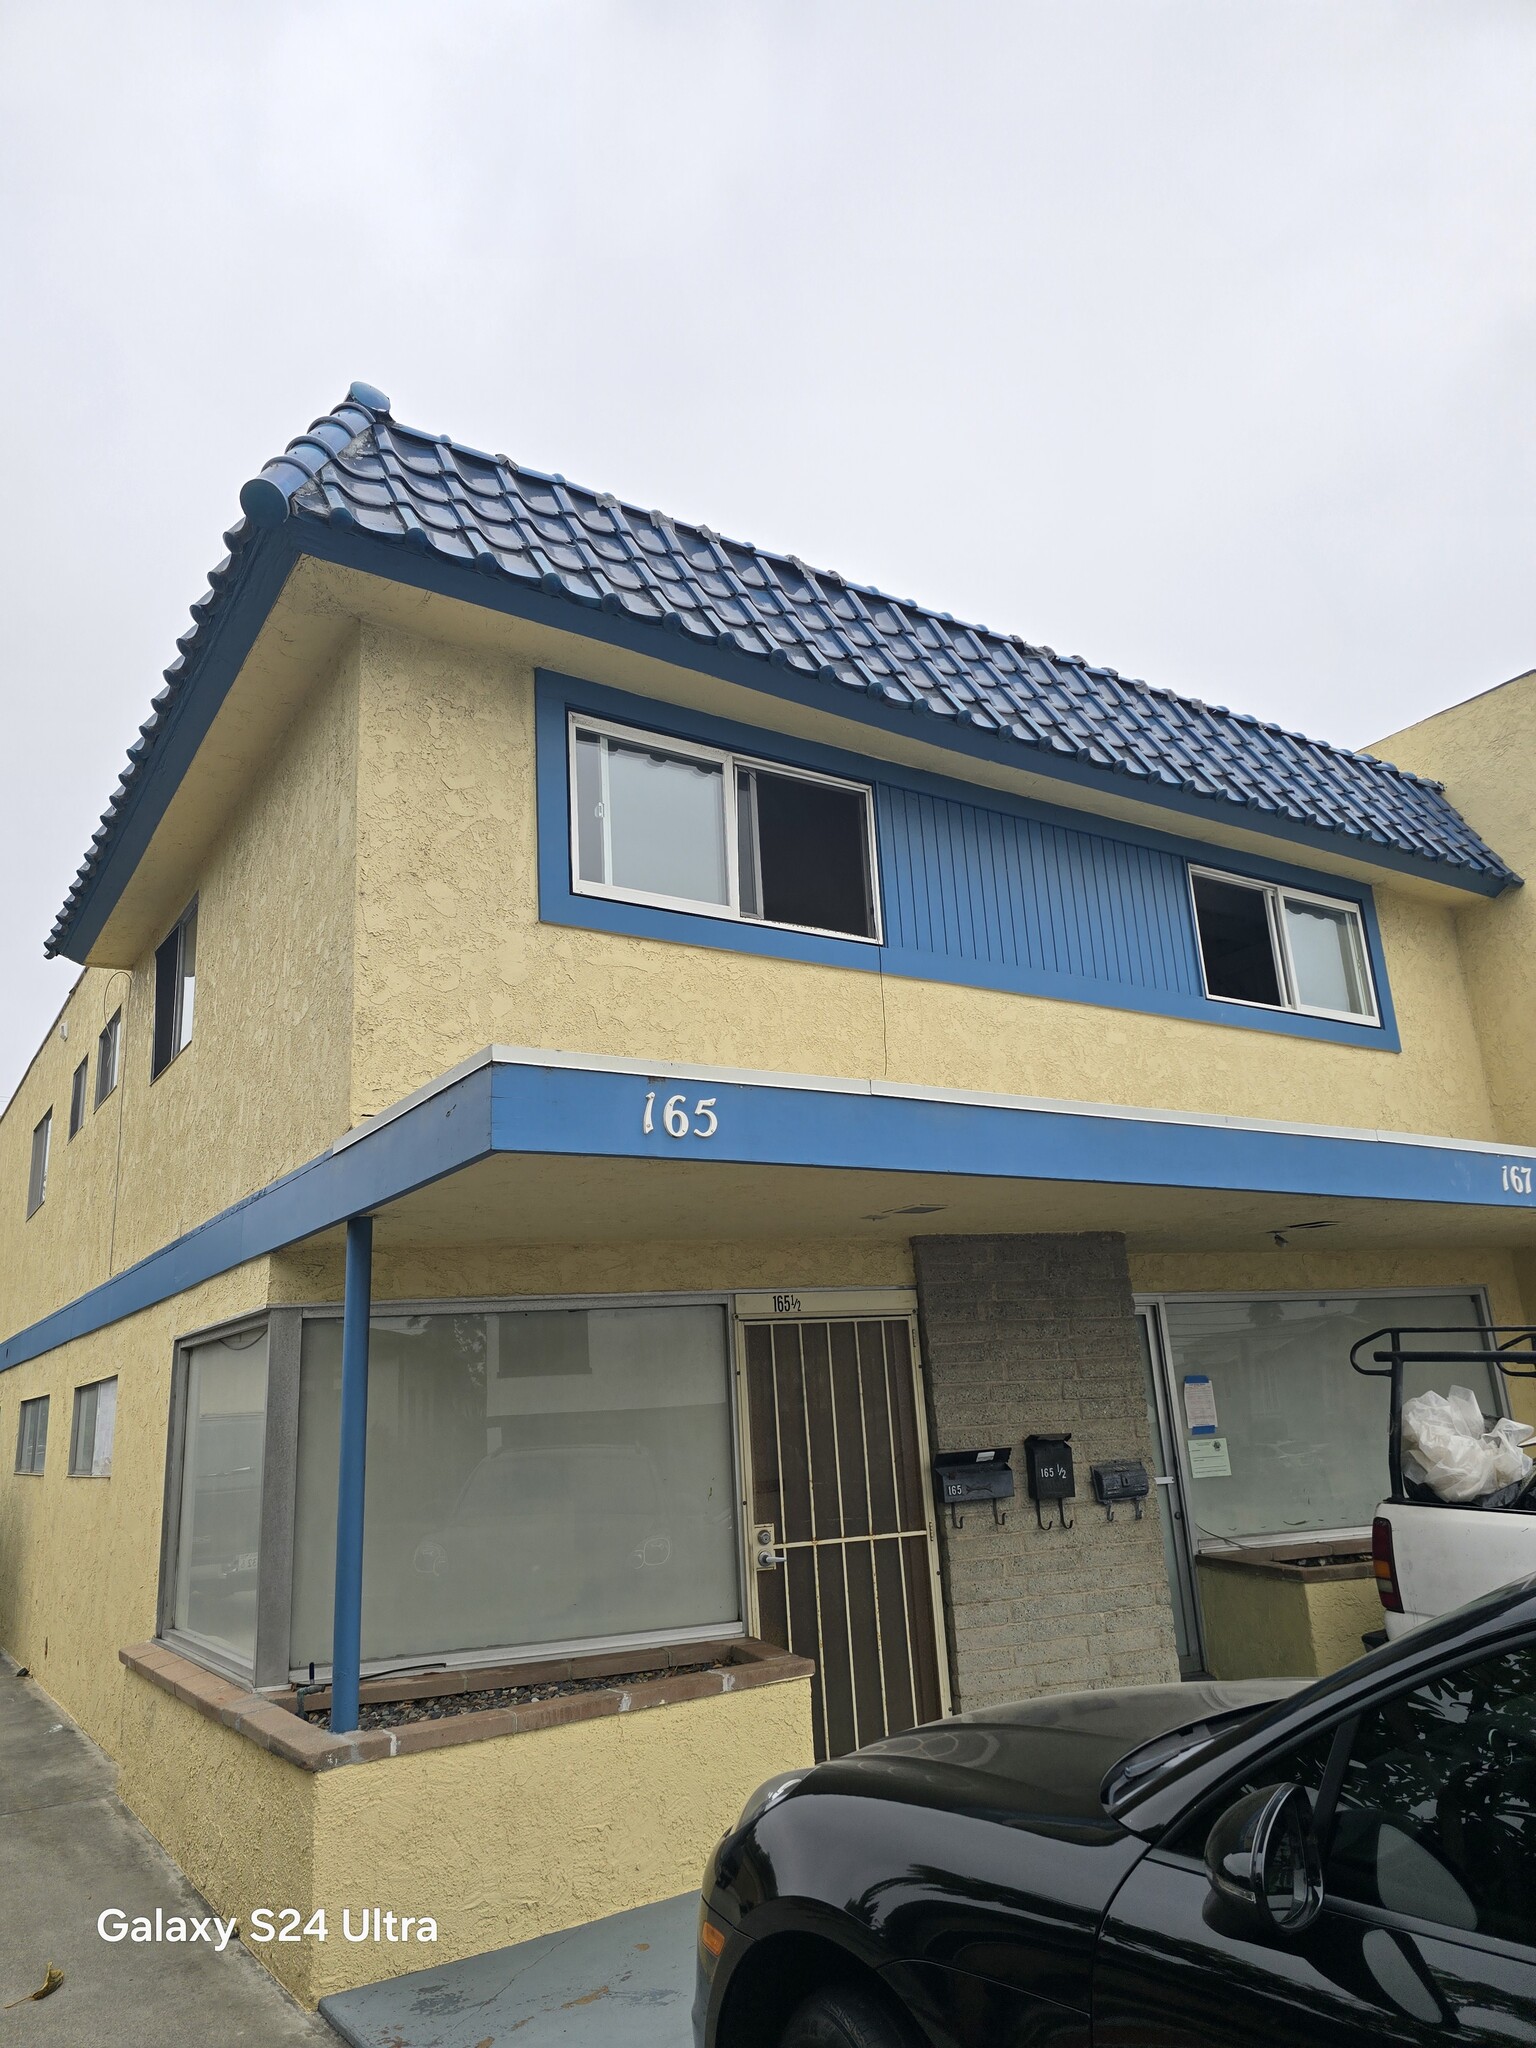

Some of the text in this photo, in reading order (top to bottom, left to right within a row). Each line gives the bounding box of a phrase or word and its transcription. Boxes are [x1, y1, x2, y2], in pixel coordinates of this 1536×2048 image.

[643, 1091, 718, 1138] 165
[1501, 1165, 1532, 1194] 167
[1040, 1467, 1054, 1478] 165
[948, 1484, 962, 1496] 165
